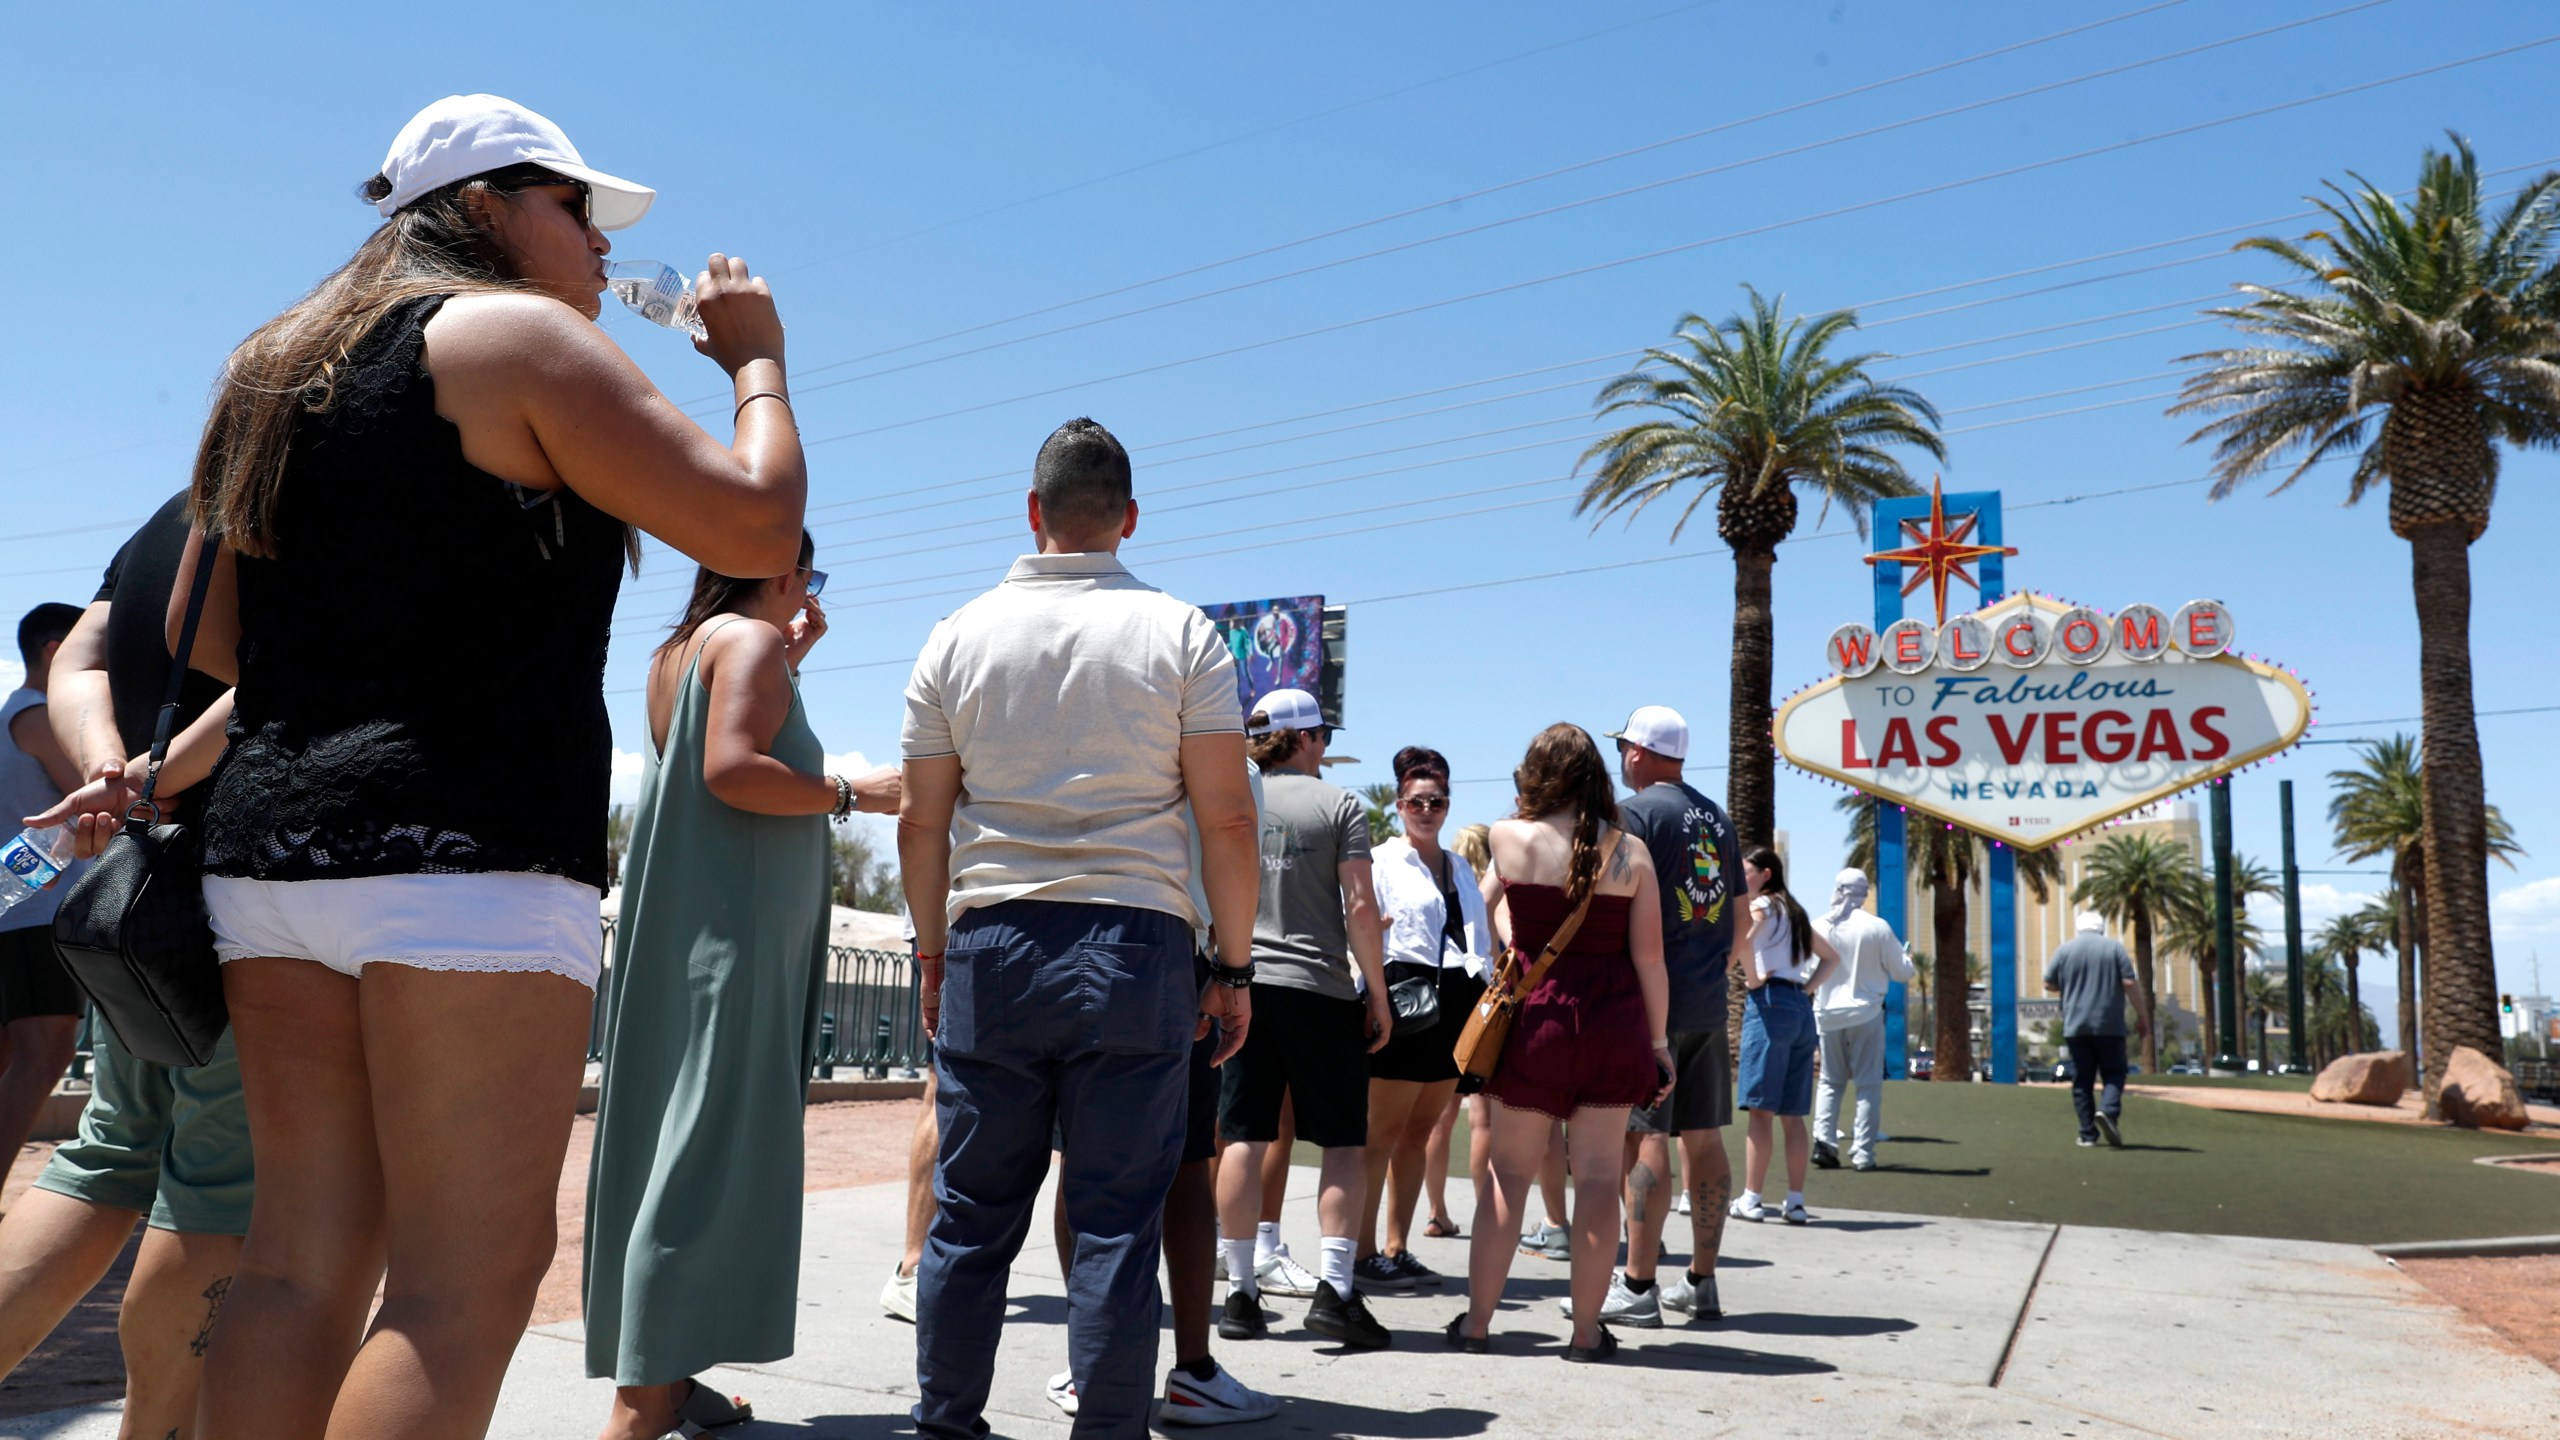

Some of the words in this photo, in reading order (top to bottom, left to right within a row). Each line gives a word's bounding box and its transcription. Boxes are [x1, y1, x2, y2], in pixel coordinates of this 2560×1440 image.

[1834, 611, 2219, 668] WELCOME
[1876, 686, 1915, 707] TO
[1931, 671, 2175, 711] Fabulous
[1841, 715, 1961, 769] LAS
[1986, 706, 2231, 766] VEGAS
[1950, 779, 2100, 800] NEVADA
[1682, 807, 1725, 838] VOLCOM
[13, 853, 30, 869] Life
[19, 846, 39, 865] Pure
[1684, 876, 1725, 905] HAWAII
